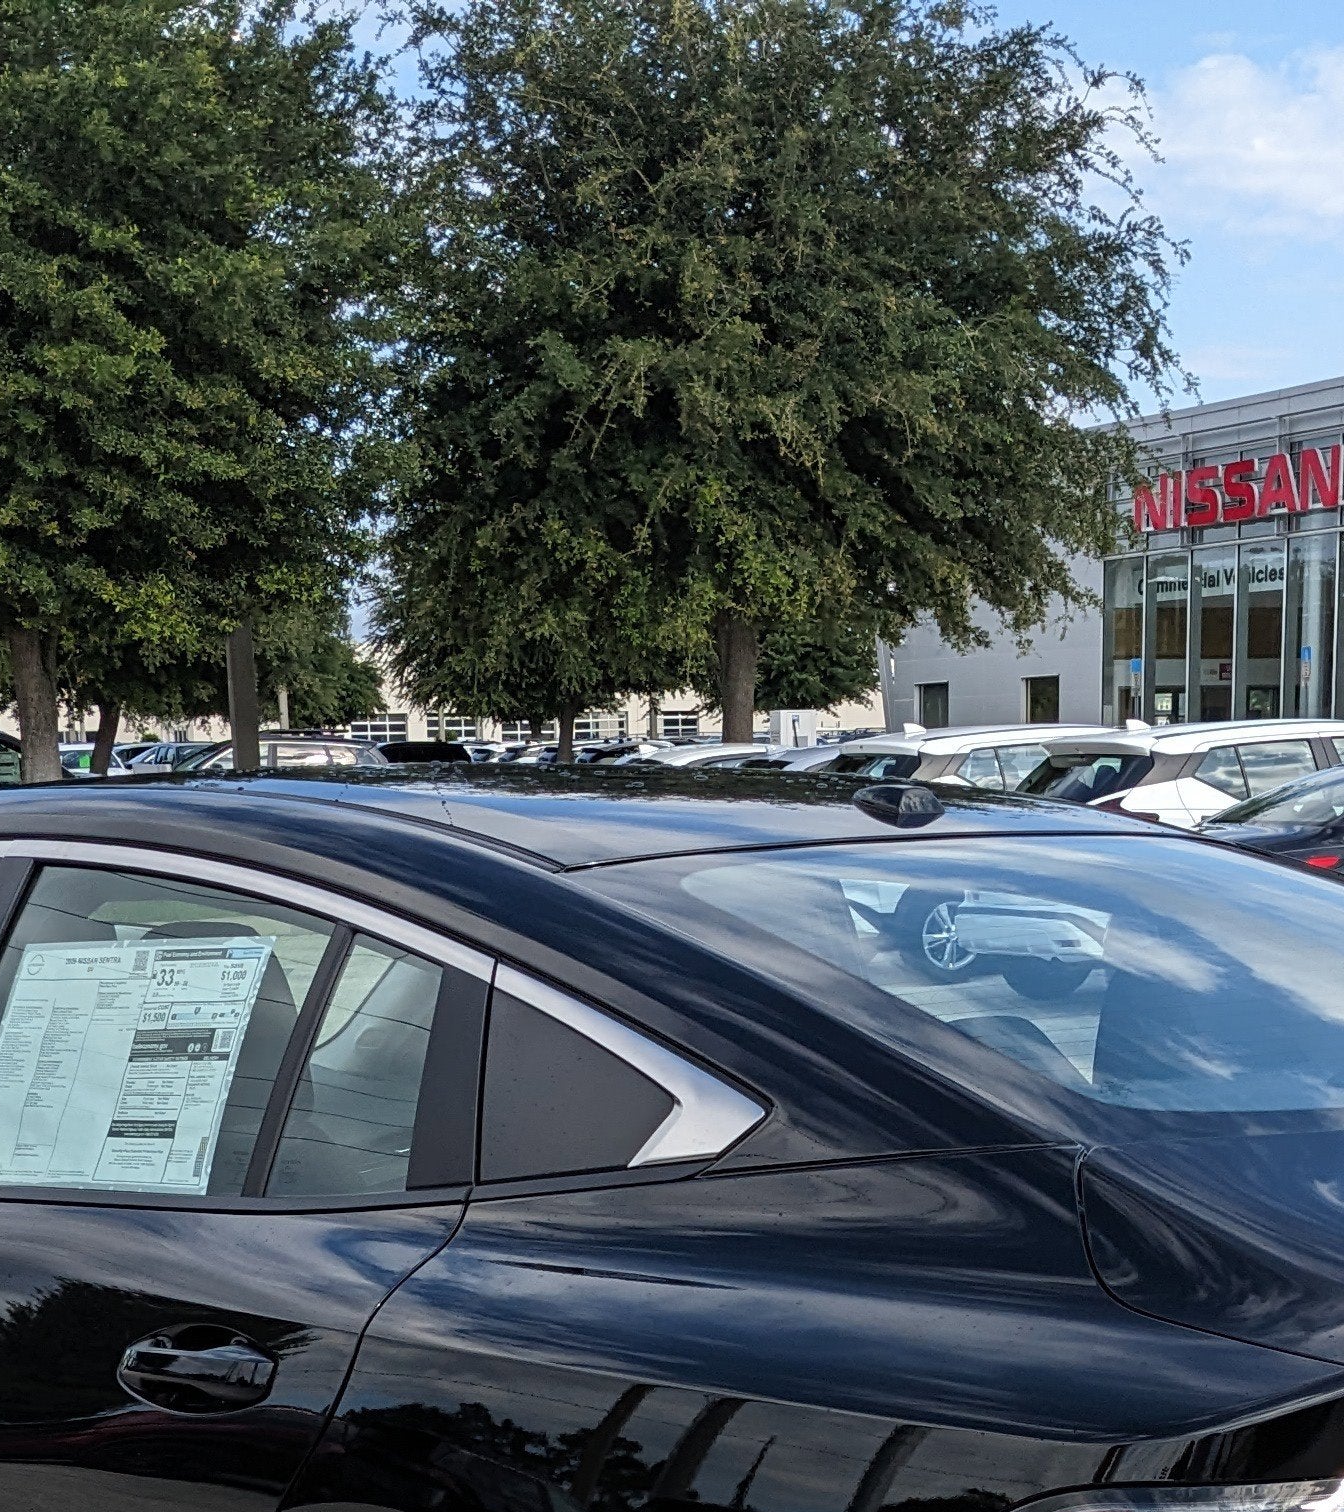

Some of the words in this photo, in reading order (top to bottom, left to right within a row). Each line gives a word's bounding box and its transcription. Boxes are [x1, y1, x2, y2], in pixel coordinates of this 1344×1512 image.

[1134, 444, 1344, 534] NISSAN
[1138, 569, 1220, 596] Cmmeial
[1223, 564, 1285, 586] Vicles
[157, 968, 175, 986] 33
[221, 970, 247, 981] $1,000
